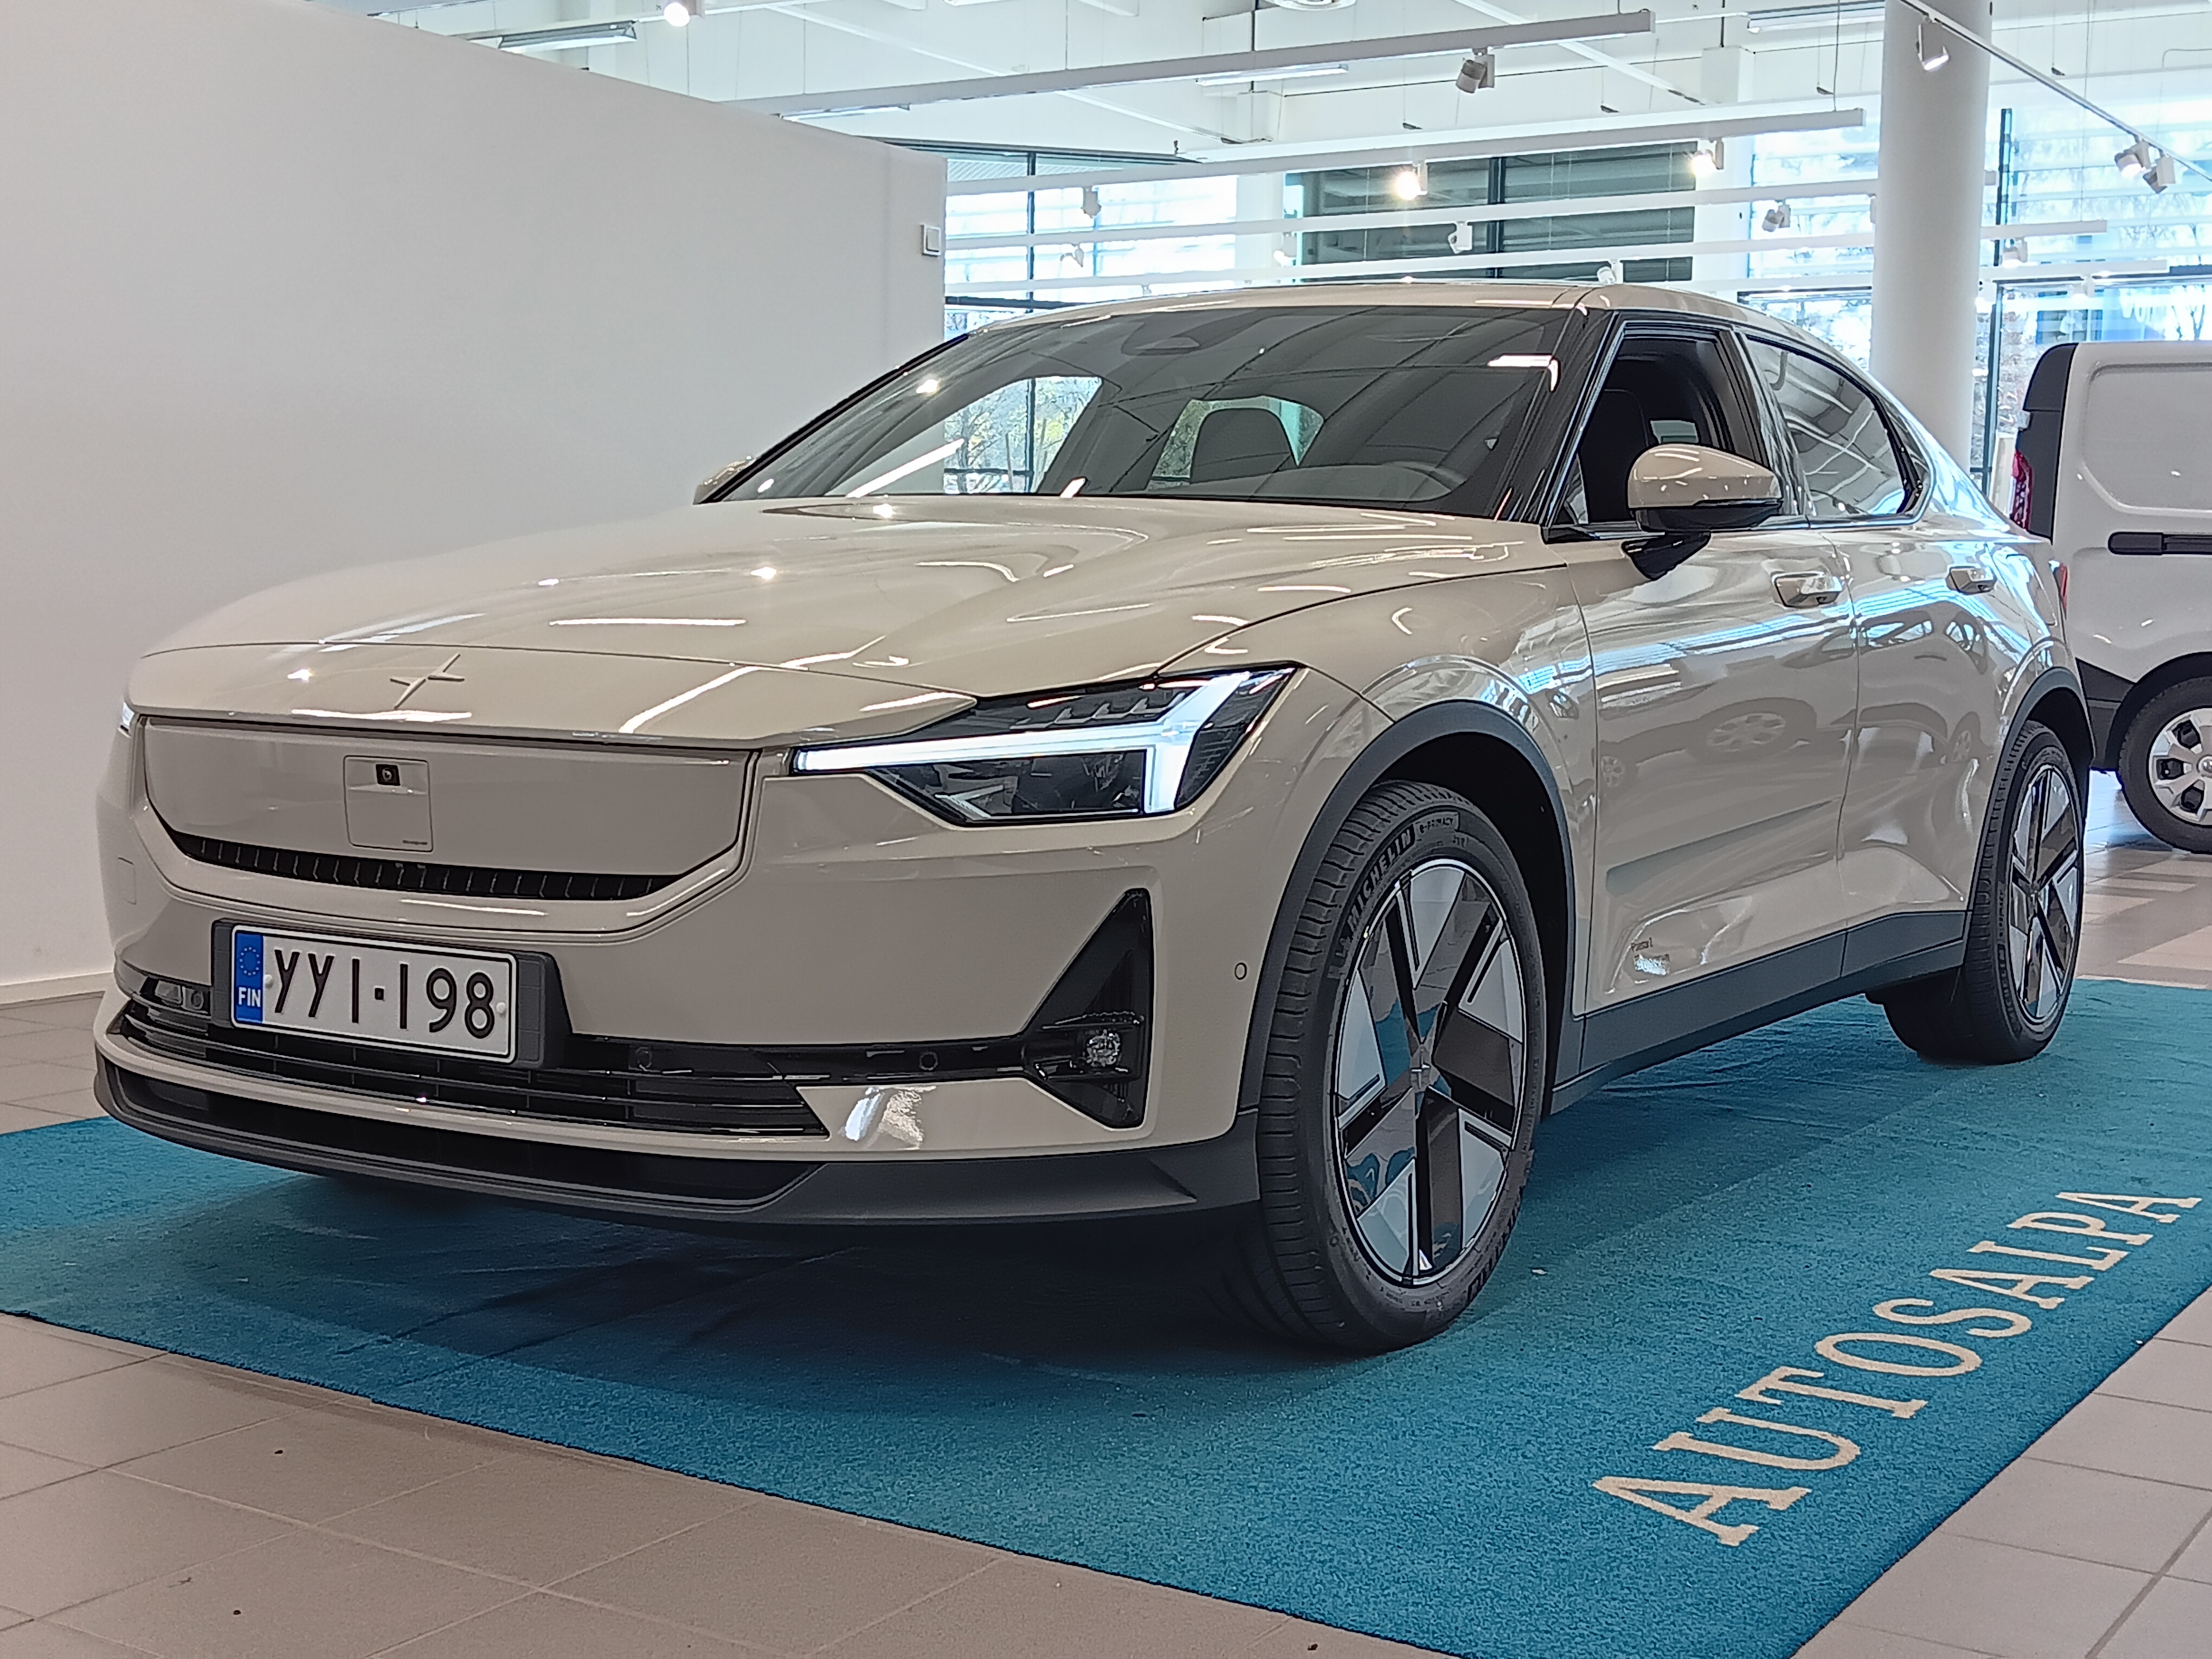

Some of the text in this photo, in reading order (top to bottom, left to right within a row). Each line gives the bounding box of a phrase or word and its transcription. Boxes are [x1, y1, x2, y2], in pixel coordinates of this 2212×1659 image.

[1347, 828, 1411, 933] MICHELIN
[239, 987, 261, 1007] FIN
[274, 949, 495, 1039] YYI-198
[1592, 1191, 2202, 1546] AUTOSALPA
